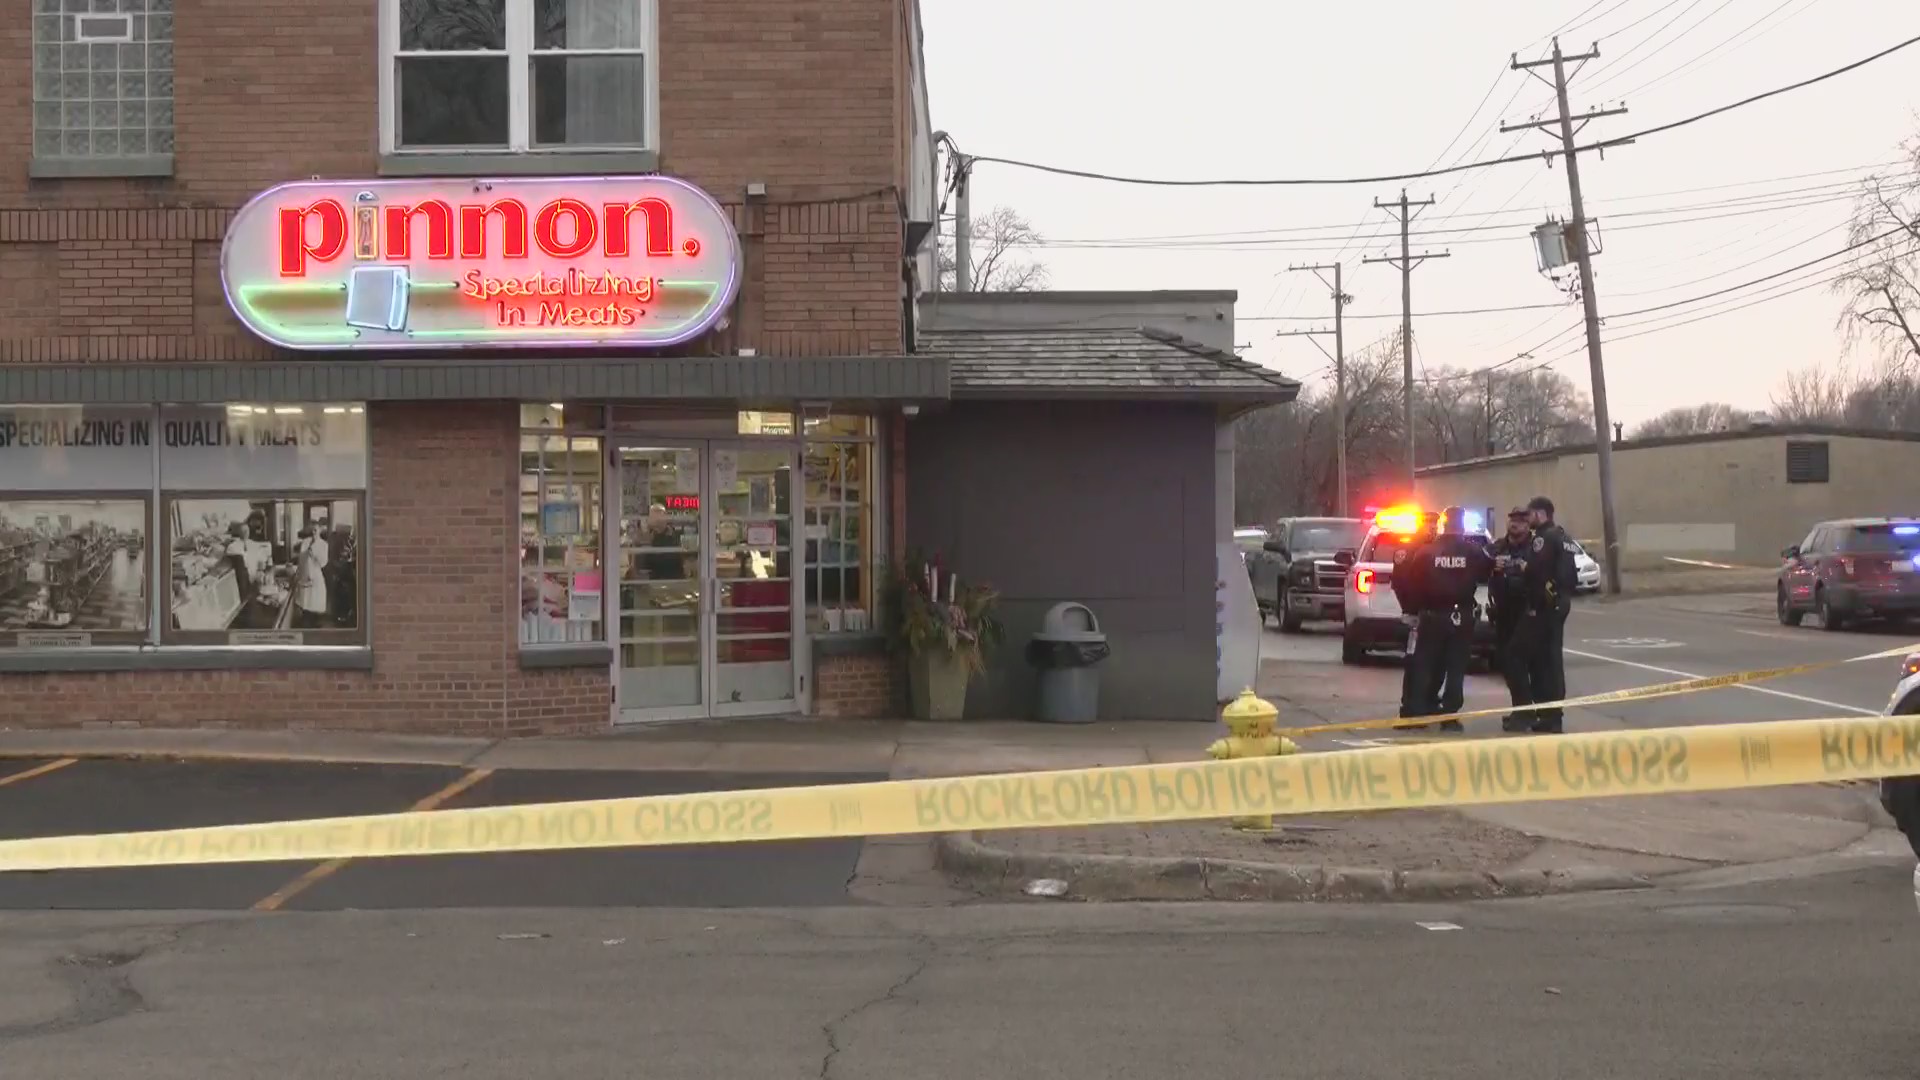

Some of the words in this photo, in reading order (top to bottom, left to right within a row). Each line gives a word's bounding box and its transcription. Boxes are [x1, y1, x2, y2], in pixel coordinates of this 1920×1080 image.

[278, 191, 700, 276] pinnon.
[464, 269, 653, 301] Specializing
[496, 302, 525, 325] In
[536, 302, 637, 326] Meats
[0, 420, 124, 447] SPECIALIZING
[131, 420, 149, 446] IN
[1434, 556, 1467, 568] POLICE
